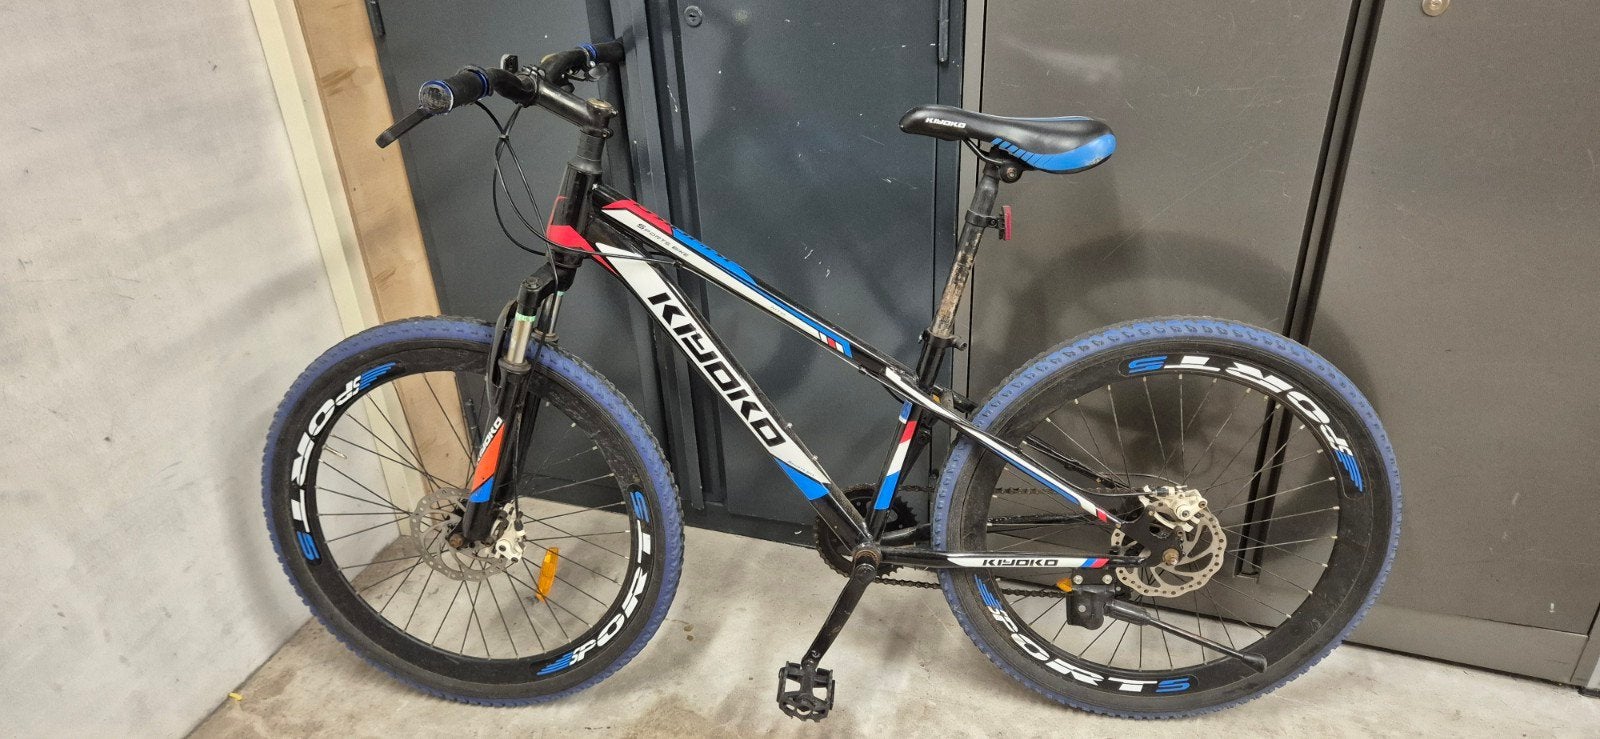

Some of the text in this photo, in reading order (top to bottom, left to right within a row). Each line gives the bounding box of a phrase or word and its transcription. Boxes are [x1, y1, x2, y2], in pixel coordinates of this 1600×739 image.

[925, 117, 967, 129] KIYOKO
[637, 223, 689, 257] SPORTS BIKE
[647, 293, 787, 447] KIYOKO
[1128, 355, 1352, 456] SPORTS
[290, 374, 363, 563] SPORTS
[569, 490, 652, 666] SPORTS
[982, 559, 1059, 567] KIYOKO
[987, 605, 1192, 694] SPORTS
